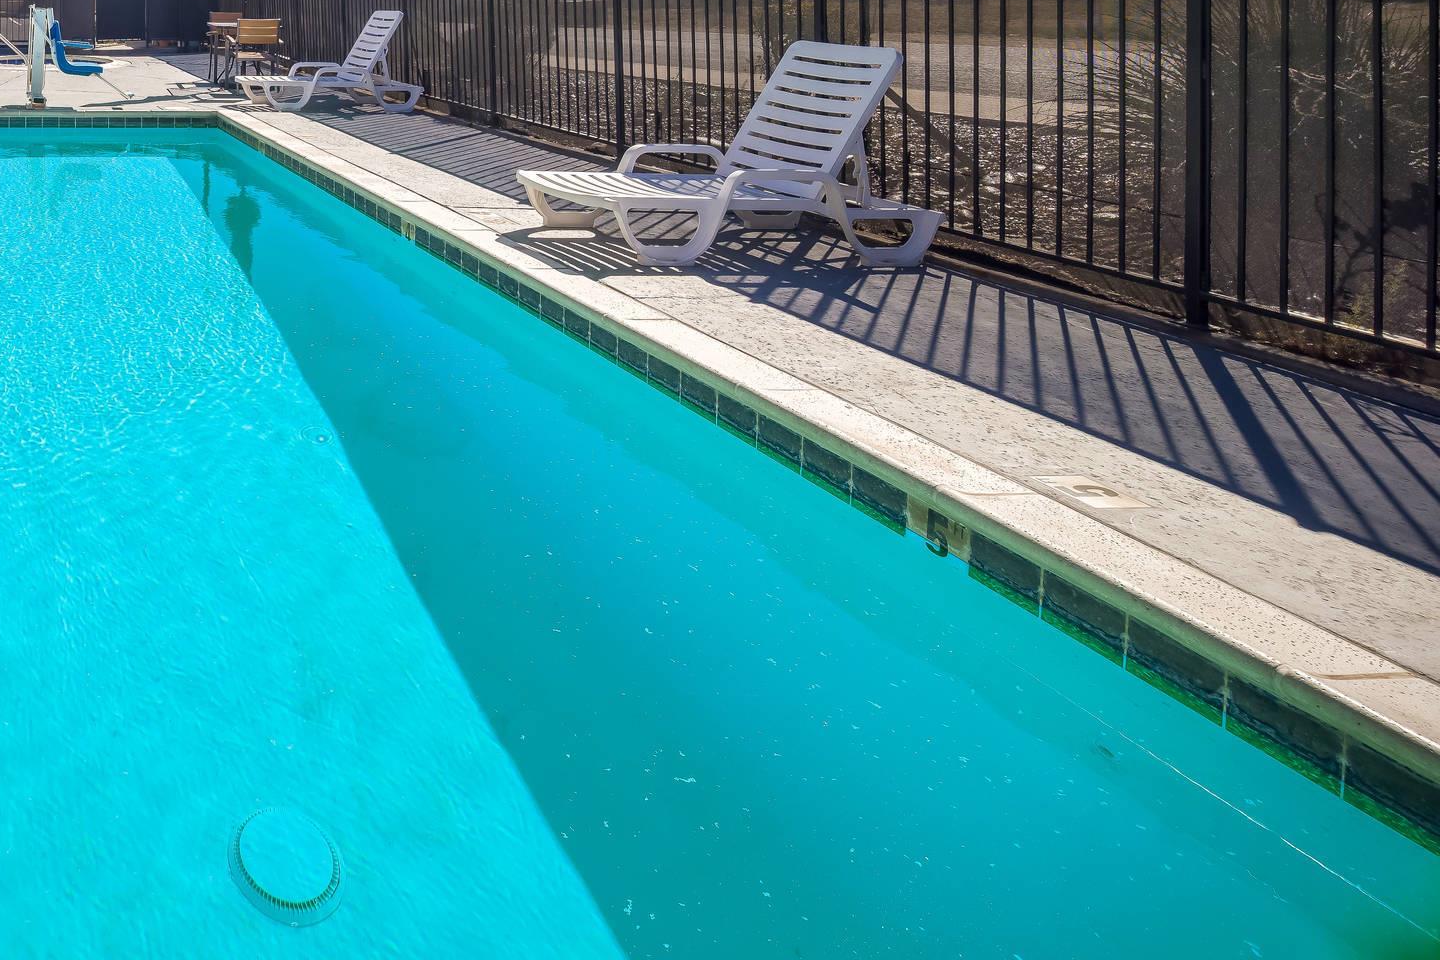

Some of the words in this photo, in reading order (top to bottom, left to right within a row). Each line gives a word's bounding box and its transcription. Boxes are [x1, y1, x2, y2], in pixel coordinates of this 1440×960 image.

[1053, 484, 1120, 498] 5
[926, 508, 949, 558] 5
[952, 521, 967, 540] FT
